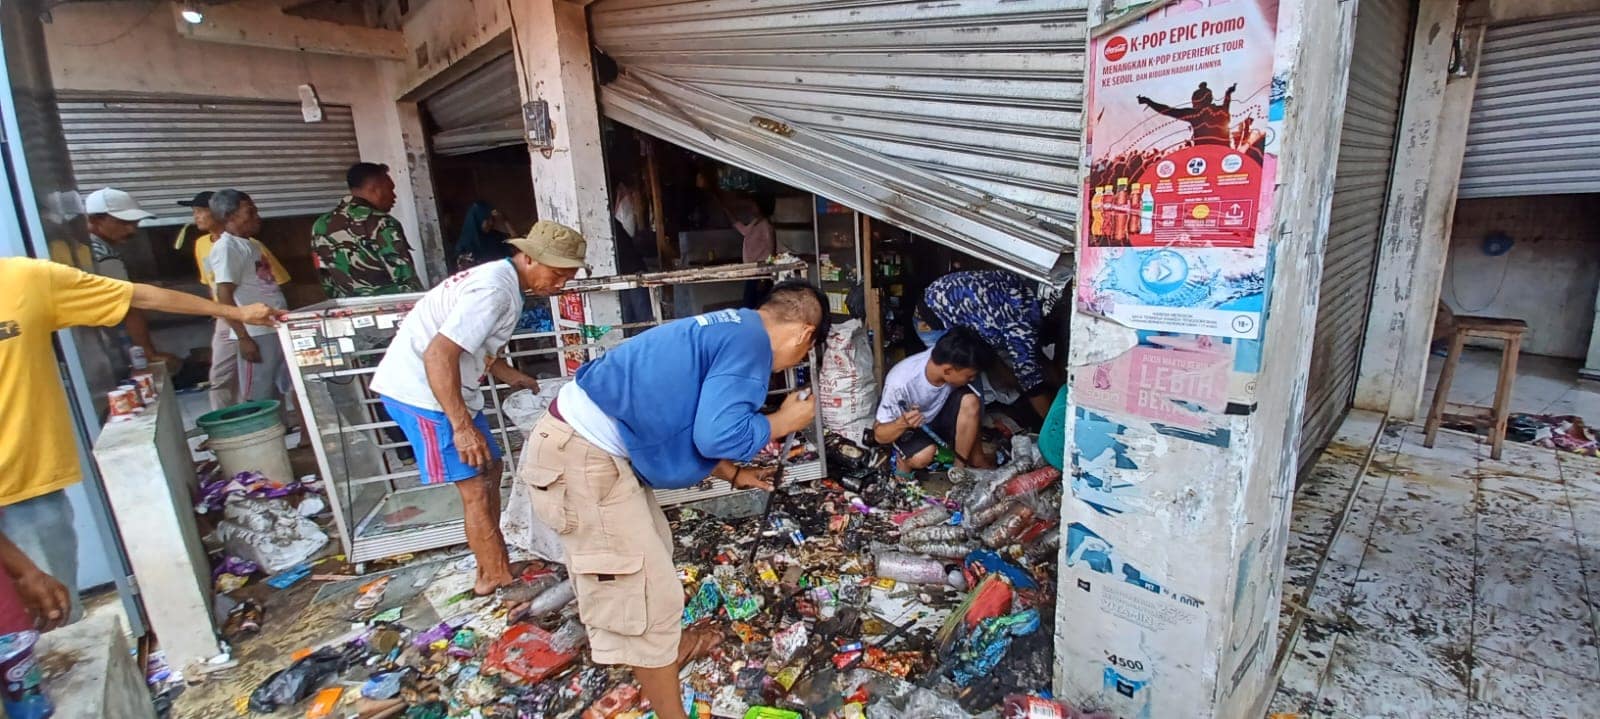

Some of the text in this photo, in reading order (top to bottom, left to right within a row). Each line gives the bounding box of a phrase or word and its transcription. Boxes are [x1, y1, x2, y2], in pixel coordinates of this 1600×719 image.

[1131, 31, 1166, 52] K-POP
[1169, 23, 1198, 44] EPIC
[1201, 15, 1245, 37] Promo
[1102, 39, 1244, 75] MENANGKAN K-POP EXPERIENCE TOUR
[1102, 77, 1111, 88] KE
[1112, 73, 1134, 87] SEOUL
[1107, 654, 1143, 670] 4500
